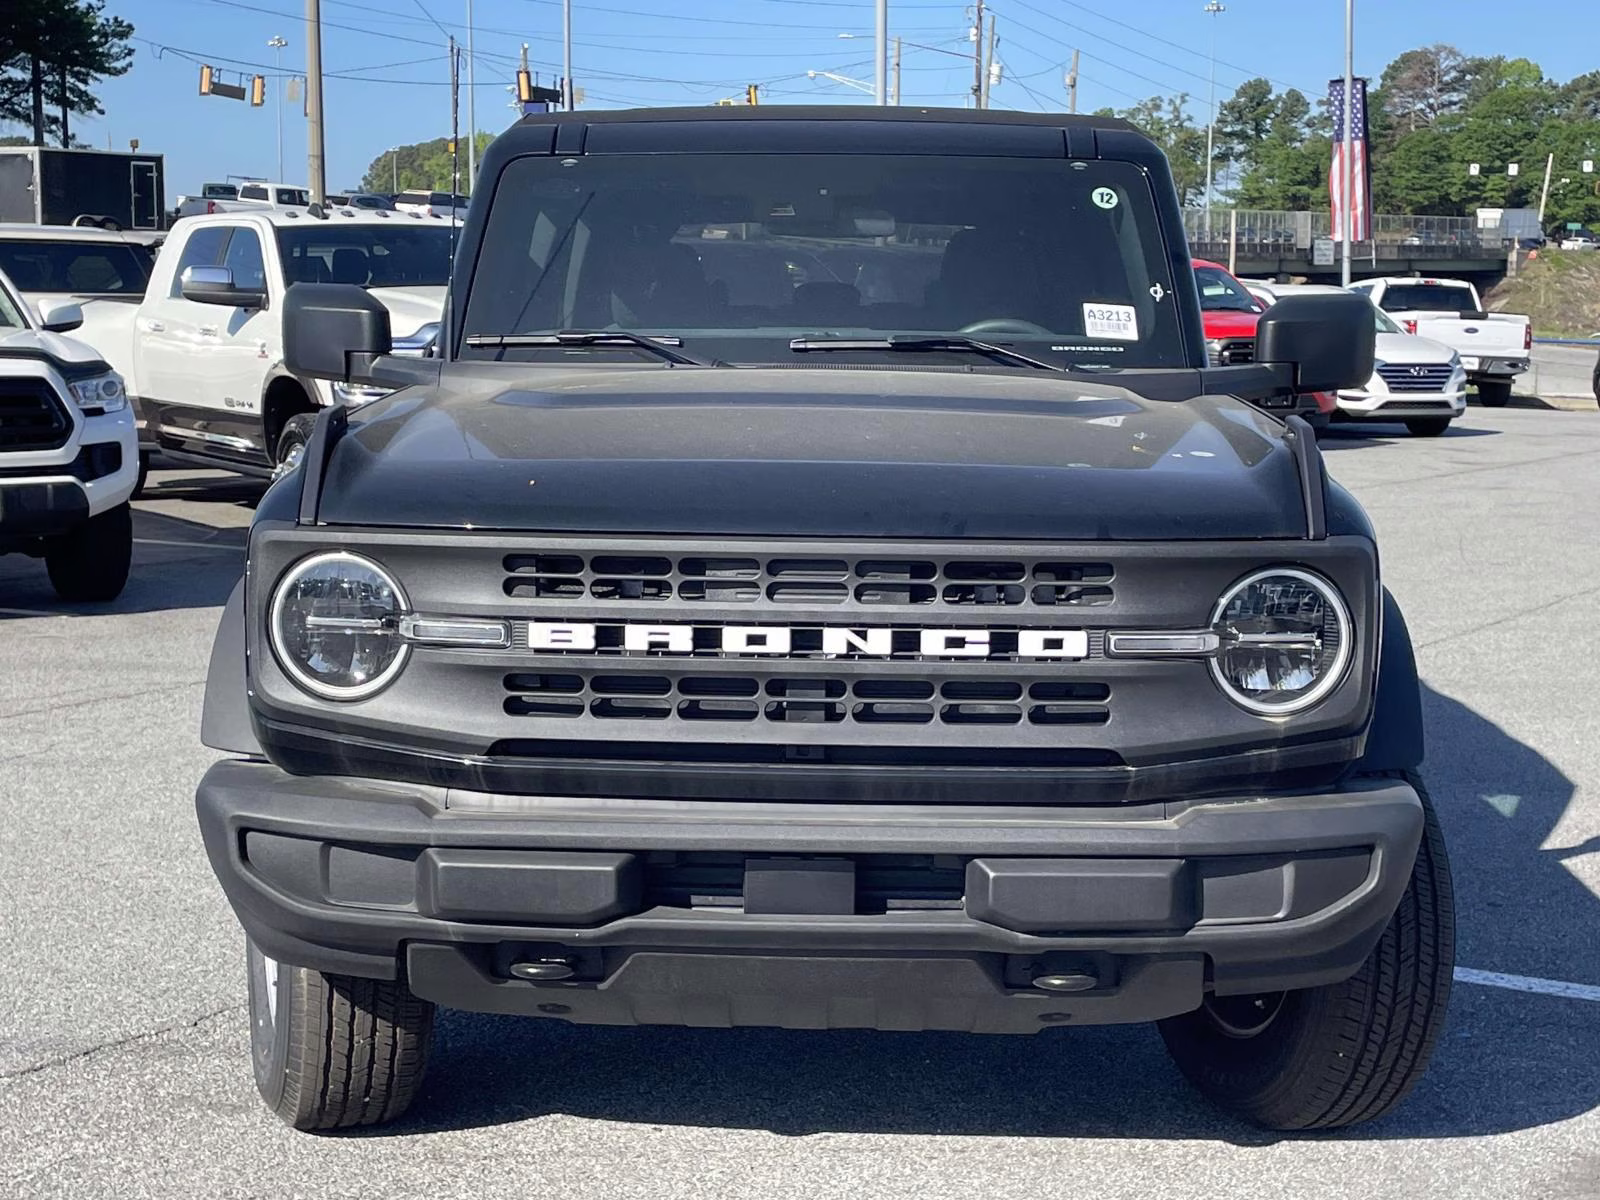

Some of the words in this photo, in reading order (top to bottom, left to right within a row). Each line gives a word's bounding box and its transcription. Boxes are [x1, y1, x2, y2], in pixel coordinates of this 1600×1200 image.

[1098, 191, 1114, 205] 12
[1088, 309, 1132, 322] A3213
[527, 622, 1089, 657] BRONCO
